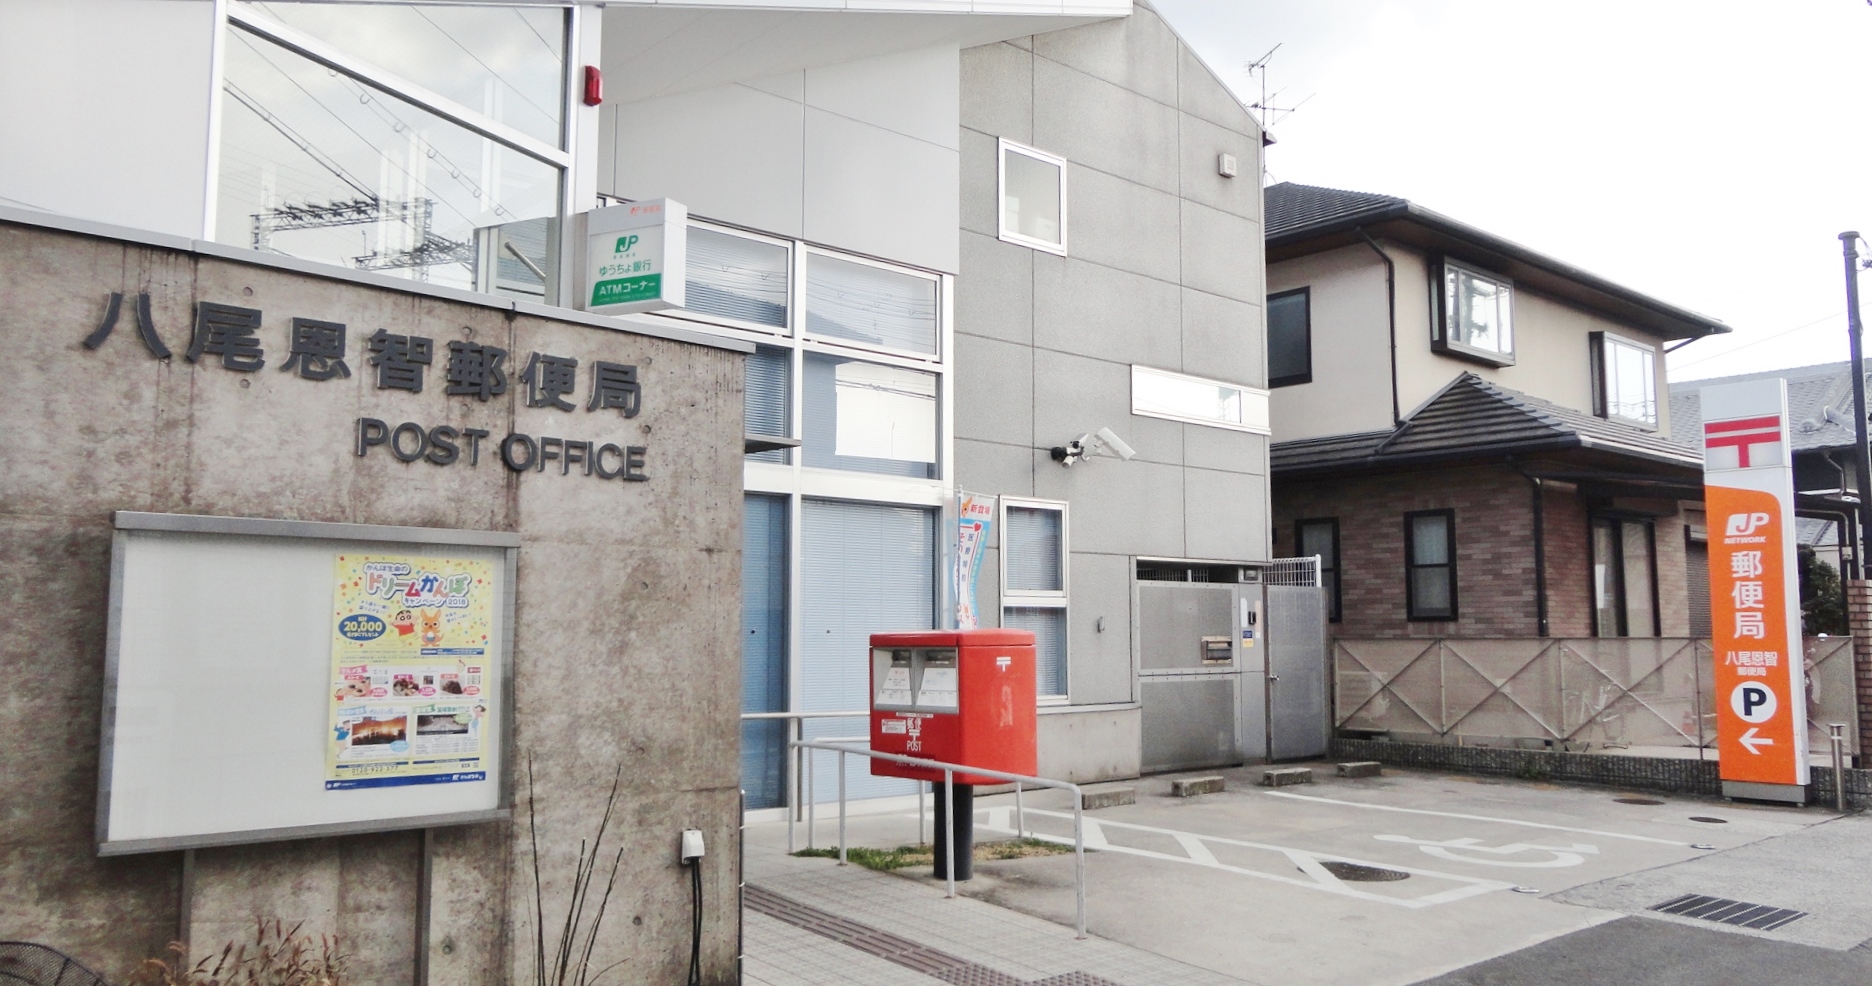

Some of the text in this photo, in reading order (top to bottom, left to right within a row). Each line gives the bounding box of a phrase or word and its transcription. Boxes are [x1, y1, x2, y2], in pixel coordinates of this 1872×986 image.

[599, 259, 652, 277] ゆうちょ銀行
[599, 280, 656, 295] ATMコーナー
[82, 291, 642, 418] 八尾恩智郵便局
[356, 417, 649, 482] POST OFFICE
[1726, 512, 1770, 536] JP
[1724, 536, 1767, 545] NETWORK
[368, 572, 469, 598] ドリームかんぽ
[403, 598, 466, 607] キャンペーン 2018
[1731, 550, 1765, 639] 郵便局
[343, 621, 383, 633] 20,000
[1725, 651, 1778, 667] 八尾恩智
[1737, 666, 1767, 676] 郵便局
[1743, 687, 1767, 716] P
[907, 741, 922, 752] POST
